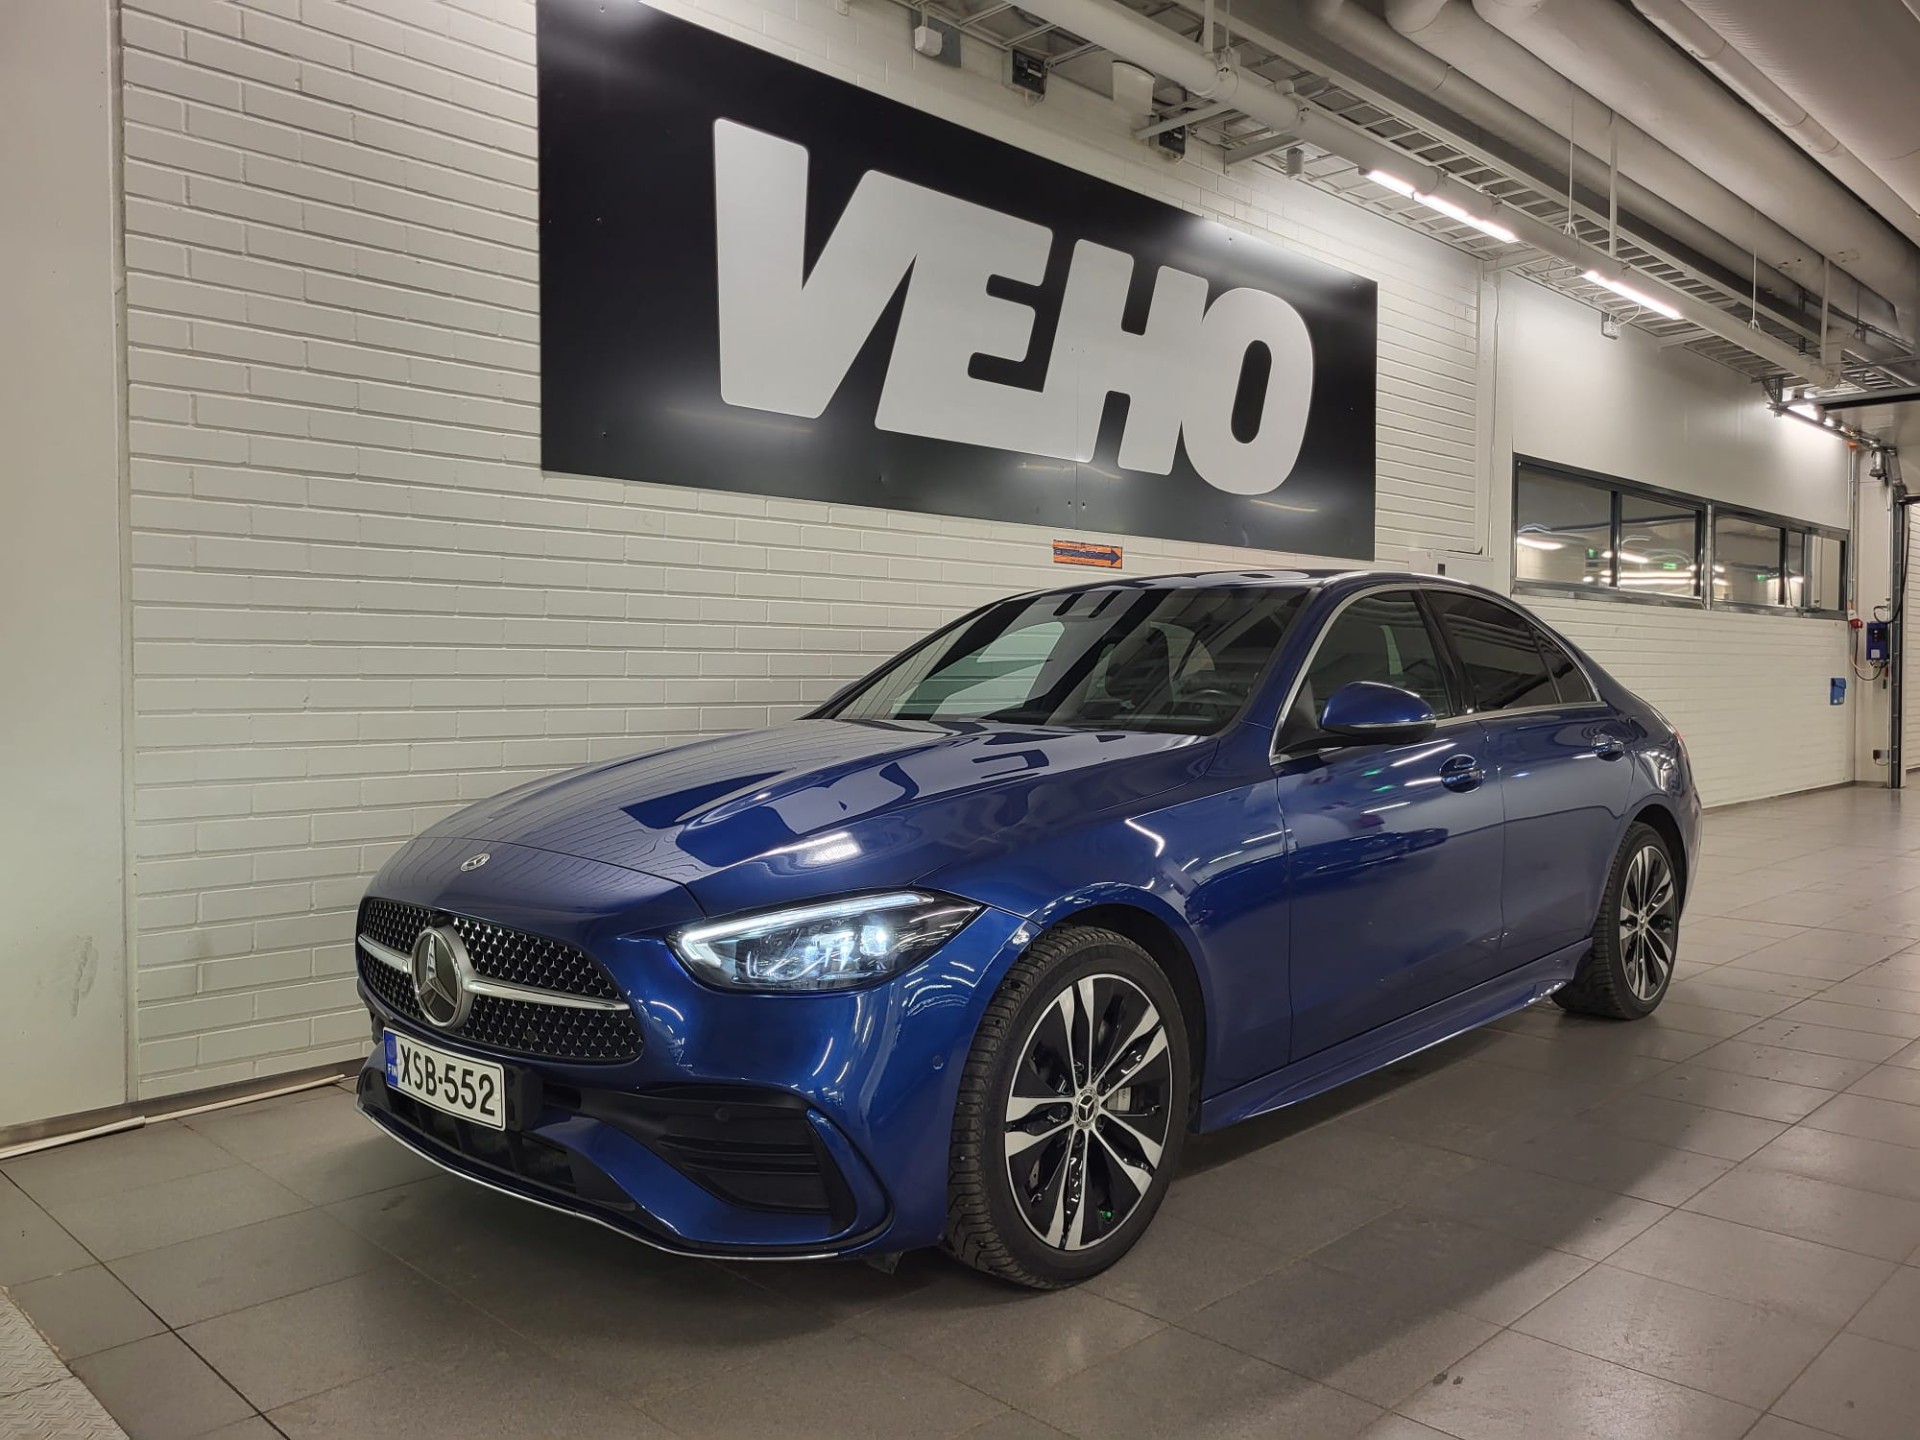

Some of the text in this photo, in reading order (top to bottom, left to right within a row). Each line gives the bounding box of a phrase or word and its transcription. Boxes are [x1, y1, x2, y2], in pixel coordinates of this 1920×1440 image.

[714, 118, 1314, 495] VEHO
[387, 1063, 398, 1077] FIN
[400, 1043, 495, 1116] XSB-552
